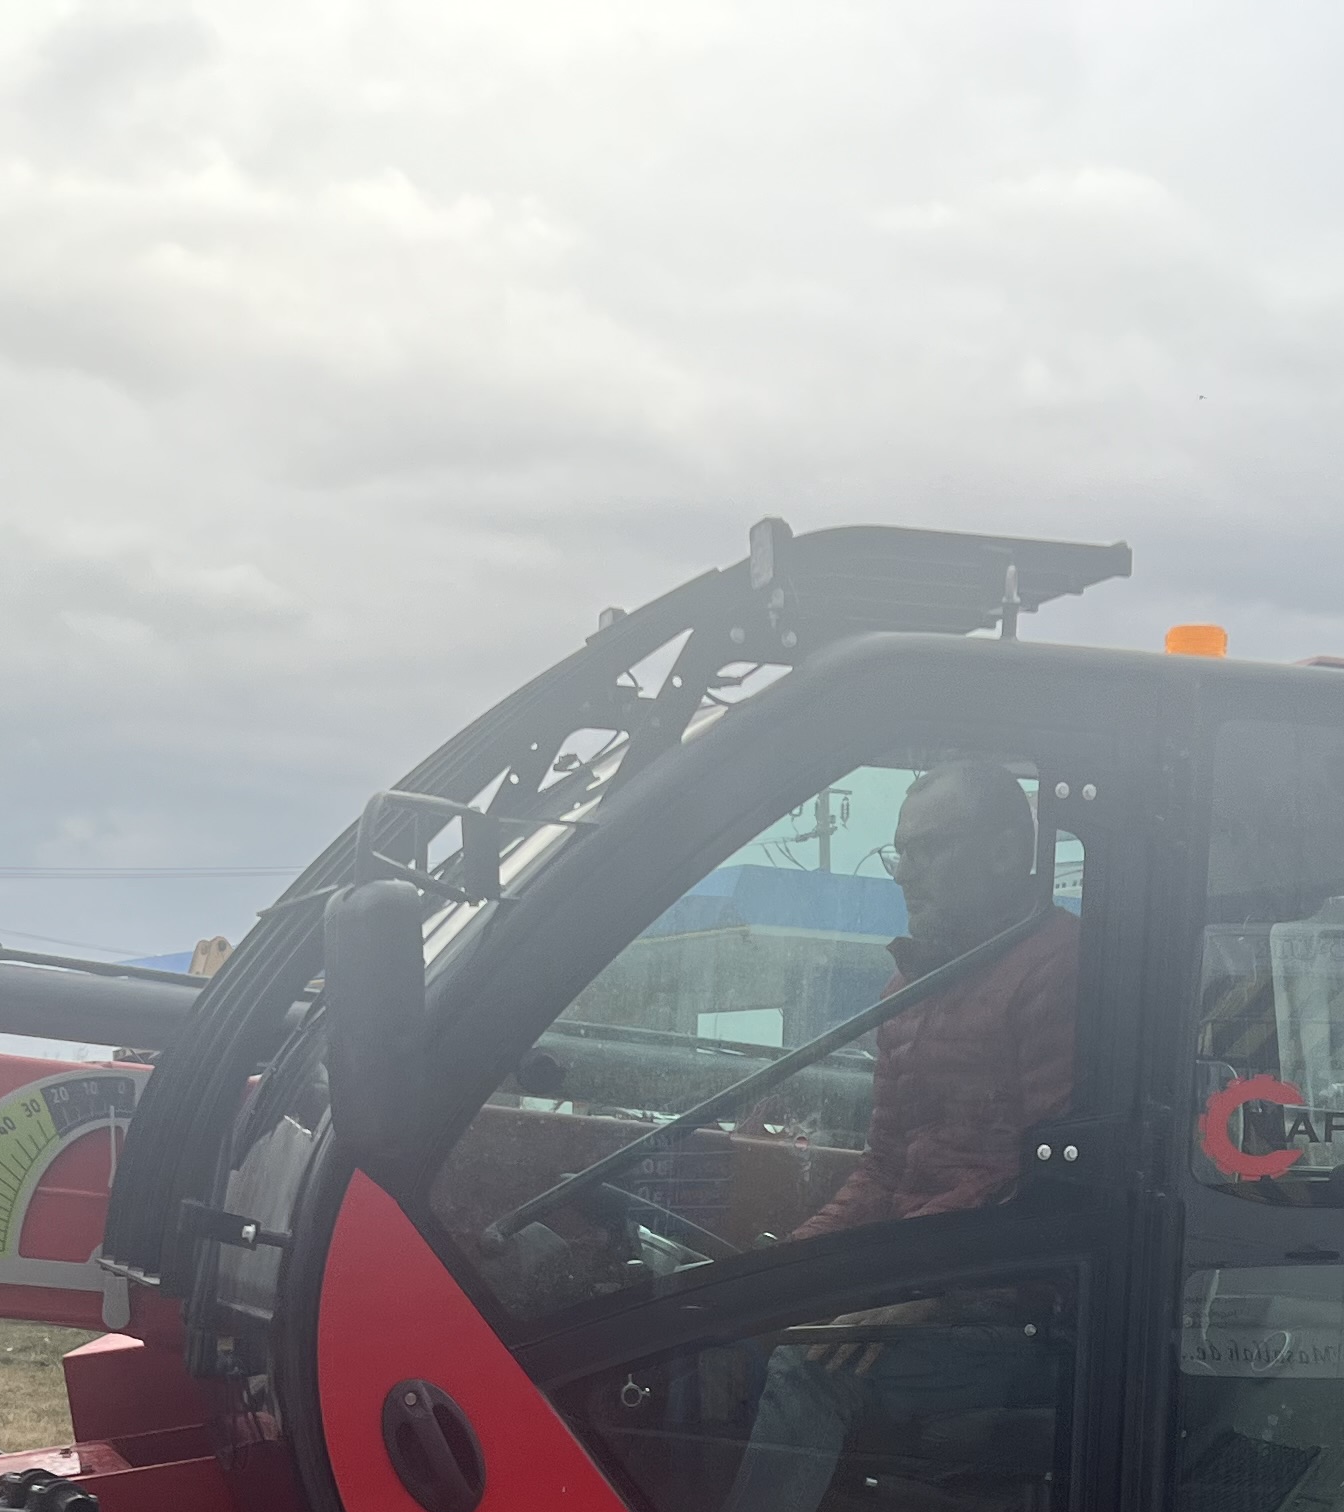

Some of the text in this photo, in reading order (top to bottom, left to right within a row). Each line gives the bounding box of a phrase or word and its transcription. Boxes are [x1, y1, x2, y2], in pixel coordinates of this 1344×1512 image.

[20, 1098, 42, 1119] 30
[50, 1086, 70, 1104] 20
[83, 1080, 99, 1095] 10
[117, 1081, 127, 1095] 0
